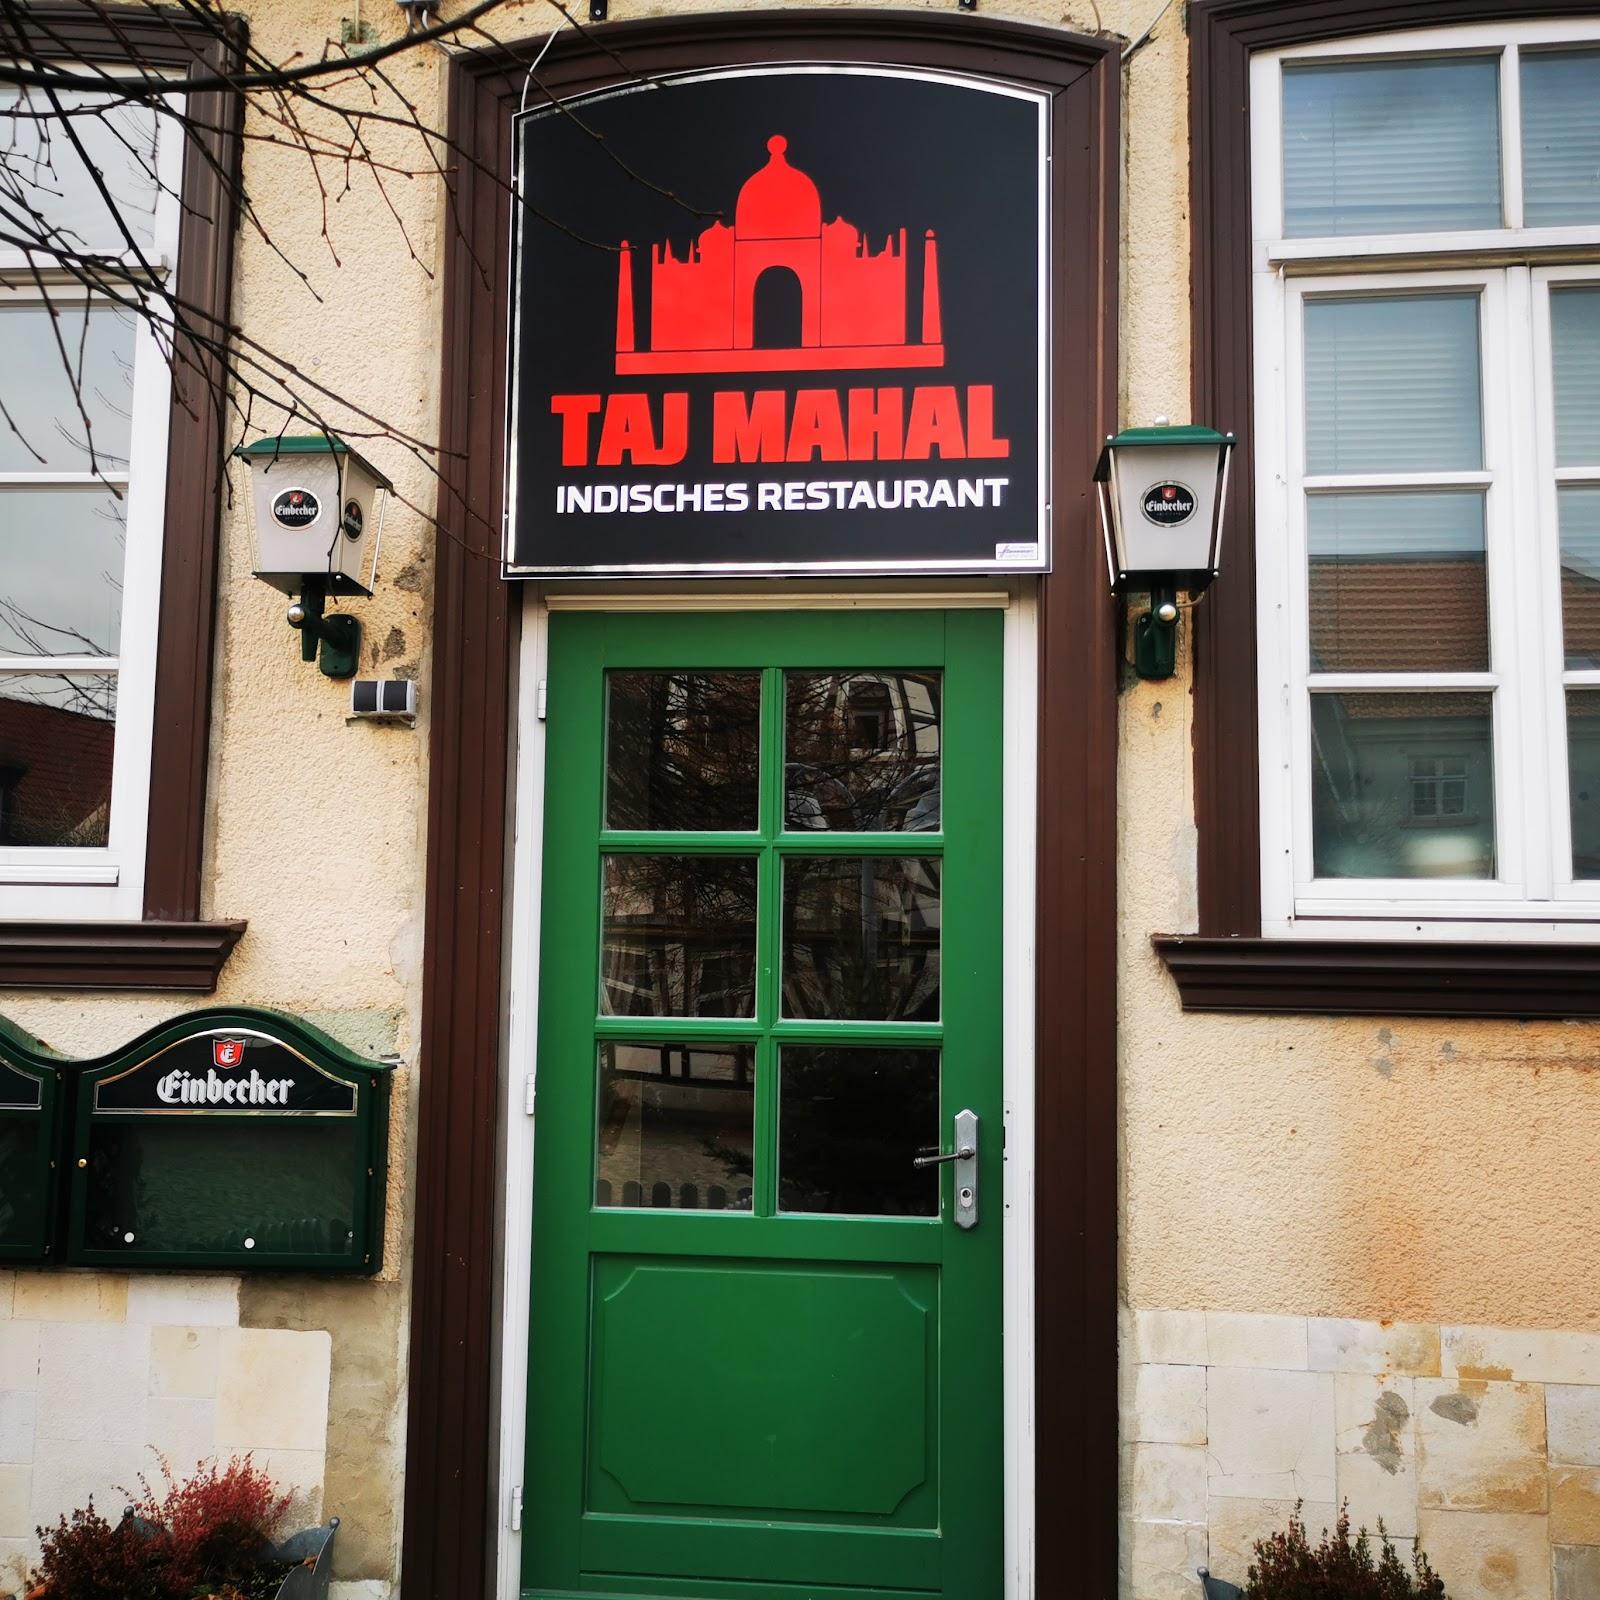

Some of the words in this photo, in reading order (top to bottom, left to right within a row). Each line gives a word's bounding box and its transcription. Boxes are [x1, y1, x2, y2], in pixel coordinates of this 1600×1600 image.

[551, 392, 688, 466] TAJ
[713, 385, 1009, 463] MAHAL
[556, 483, 748, 514] INDISCHES
[757, 478, 1009, 511] RESTAURANT
[156, 1068, 295, 1105] Einbecker
